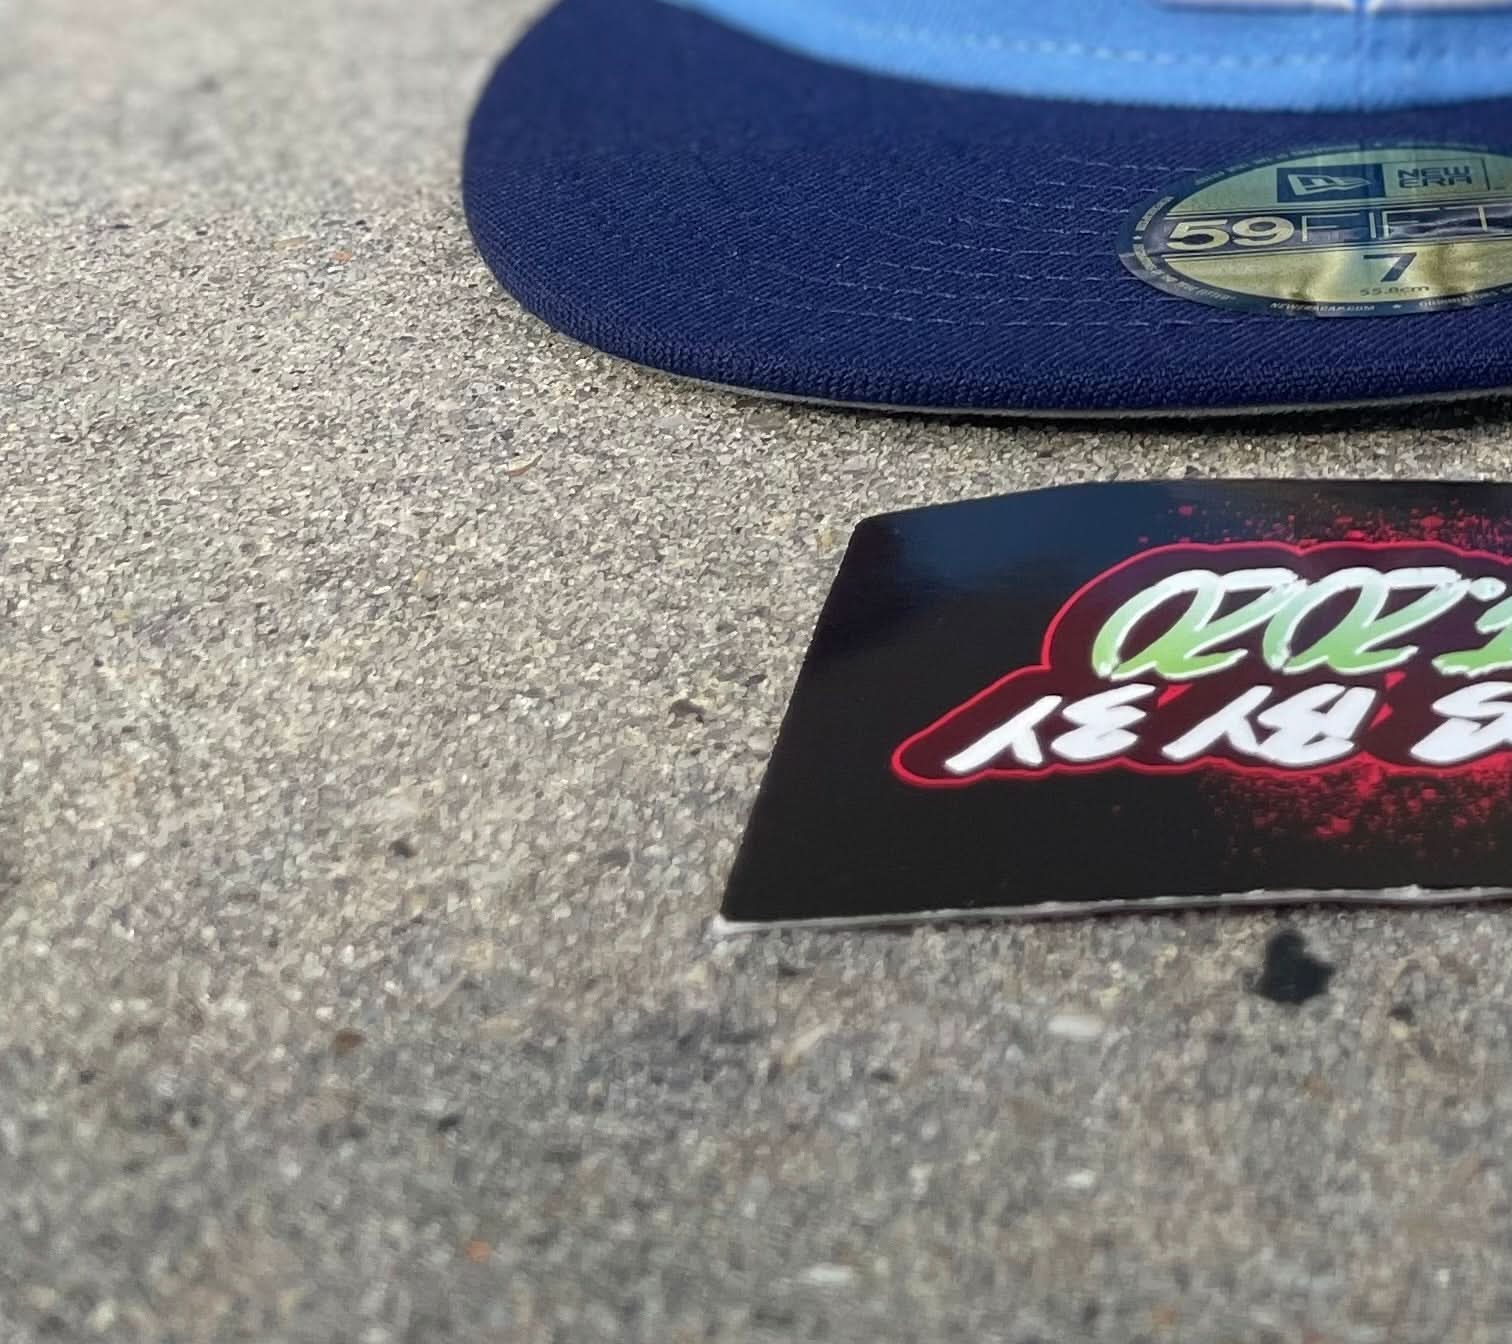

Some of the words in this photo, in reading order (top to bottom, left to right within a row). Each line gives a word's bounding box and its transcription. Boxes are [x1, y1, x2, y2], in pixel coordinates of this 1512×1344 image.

[1397, 165, 1471, 180] NEW
[1398, 175, 1473, 189] ERA
[1363, 252, 1418, 282] 7
[945, 683, 1156, 776] 3Y
[1161, 683, 1376, 766] BY
